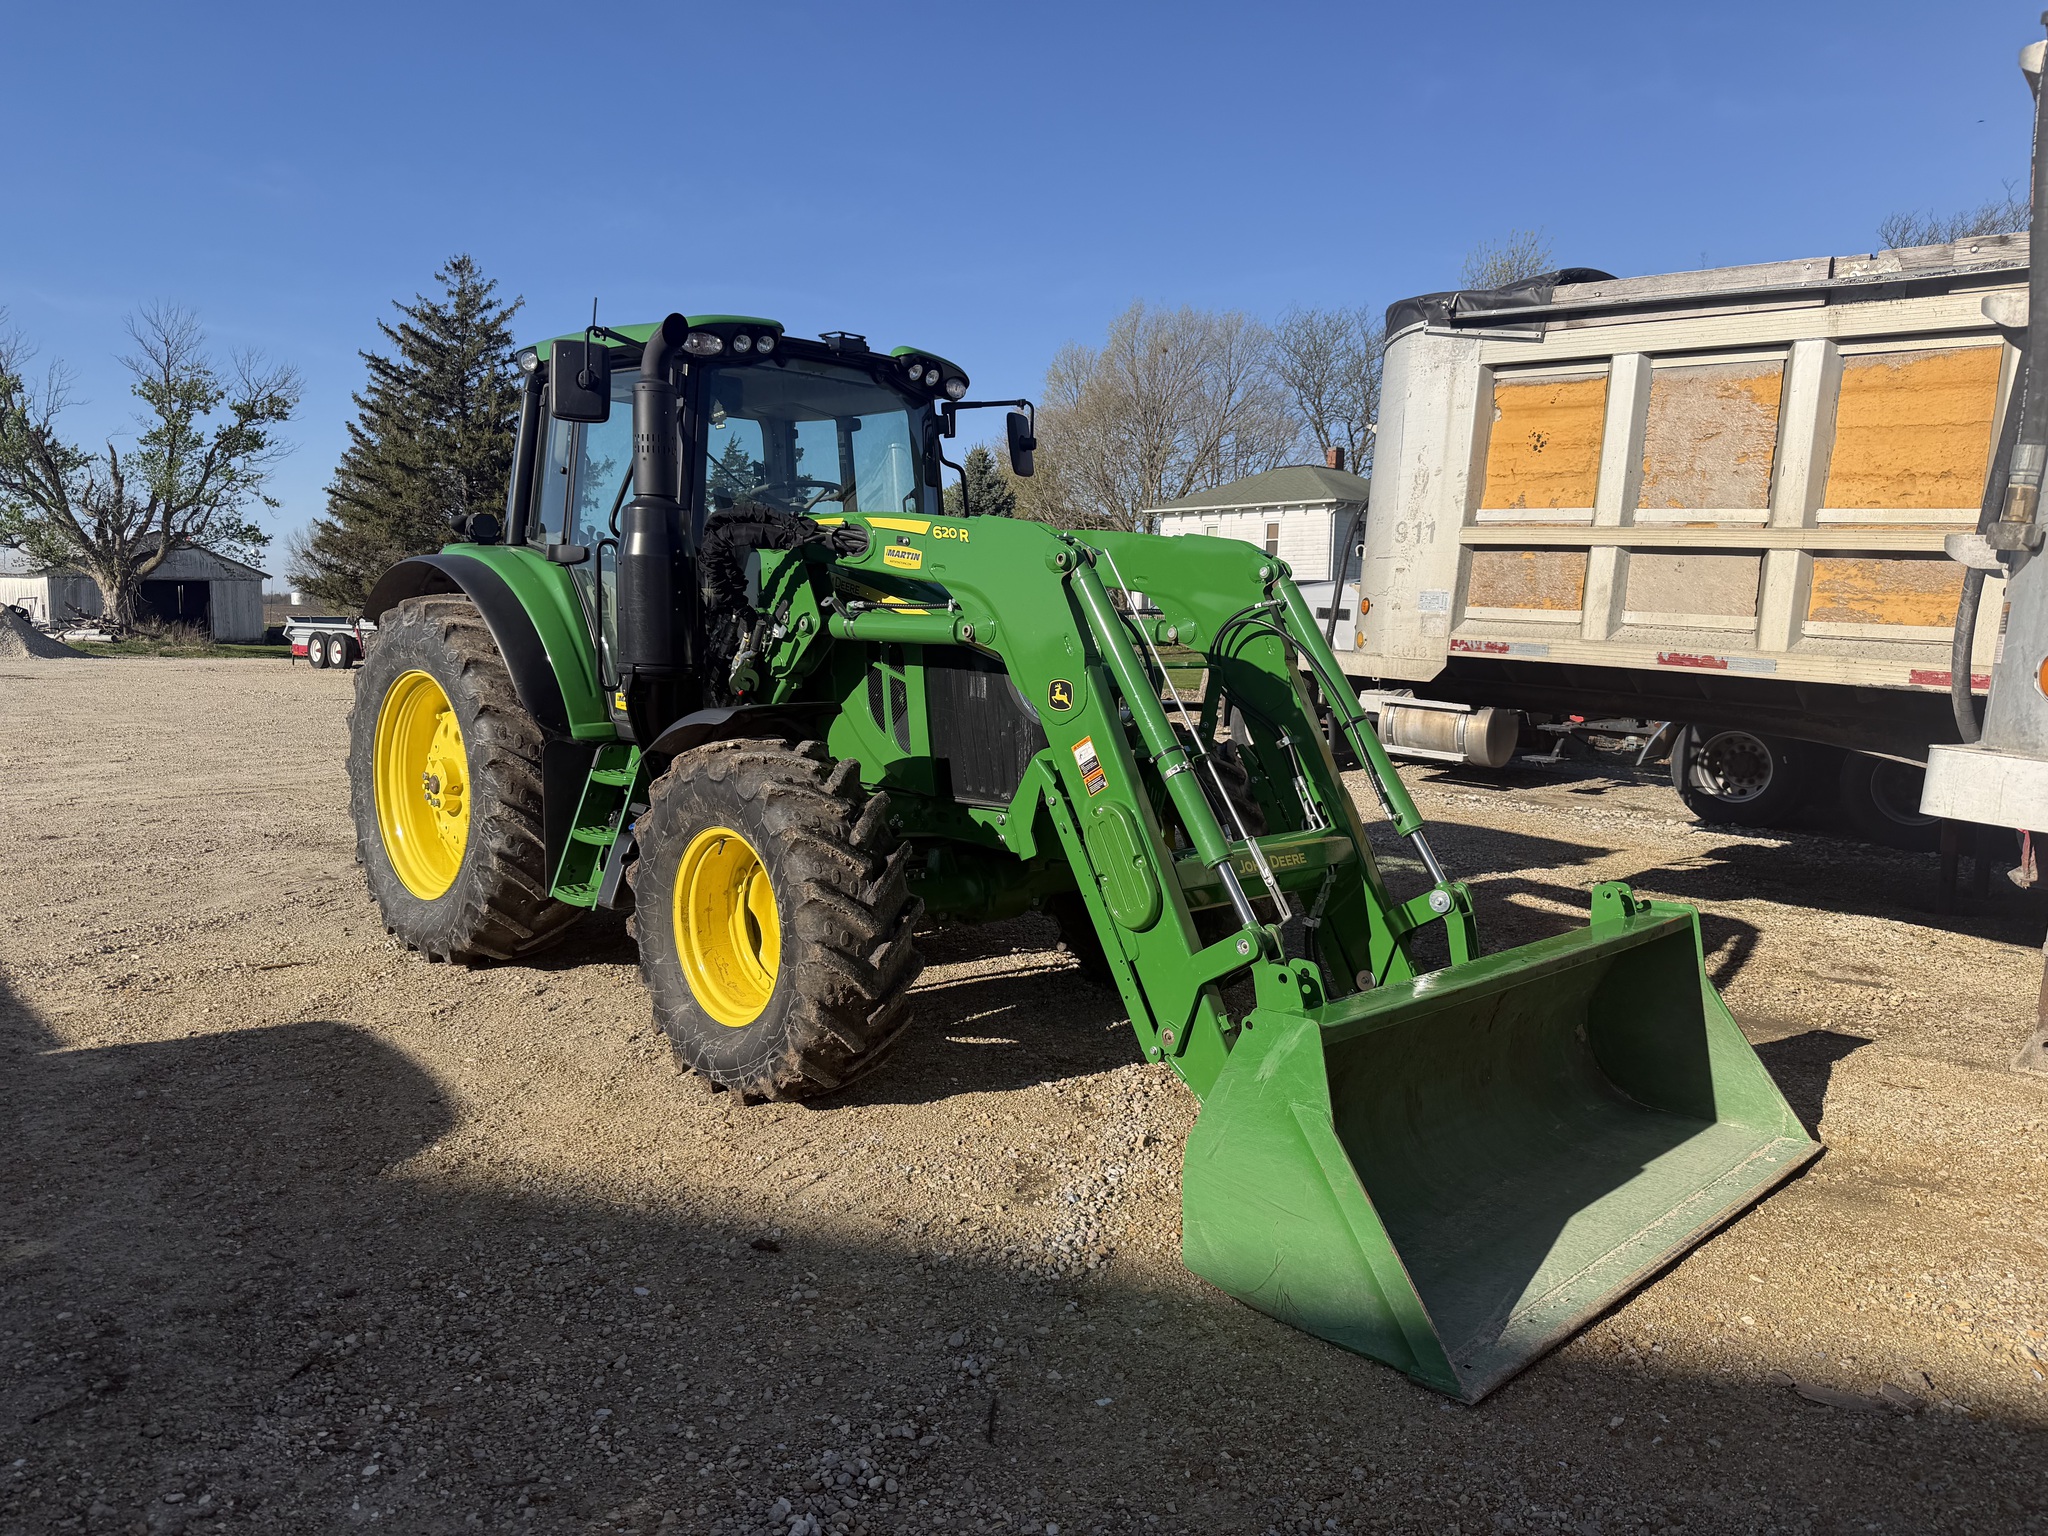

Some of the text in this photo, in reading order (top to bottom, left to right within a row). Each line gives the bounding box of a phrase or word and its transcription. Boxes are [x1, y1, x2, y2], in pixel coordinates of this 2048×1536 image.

[1395, 520, 1436, 544] 911
[887, 549, 921, 561] MARTIN
[835, 576, 860, 595] DEERE
[1240, 853, 1307, 873] JOH DEERE
